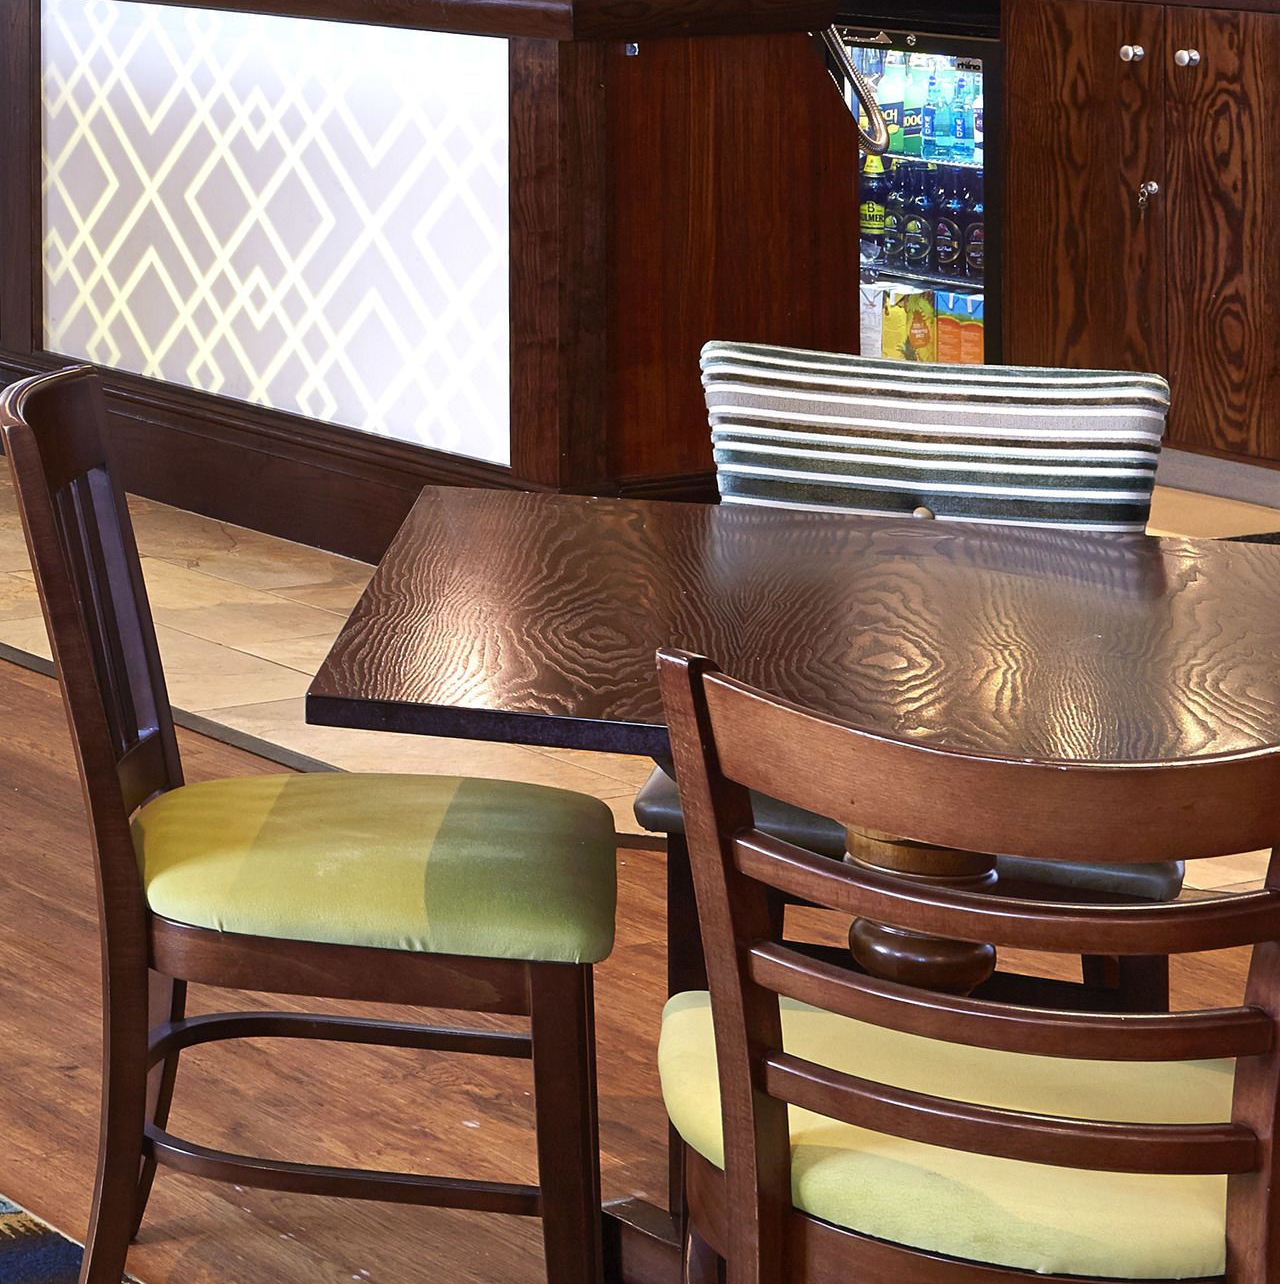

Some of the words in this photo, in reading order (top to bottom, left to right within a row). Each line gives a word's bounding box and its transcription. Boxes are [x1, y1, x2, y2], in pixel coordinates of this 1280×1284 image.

[957, 60, 981, 71] rhino
[924, 115, 932, 135] WKD
[955, 117, 964, 138] WKD
